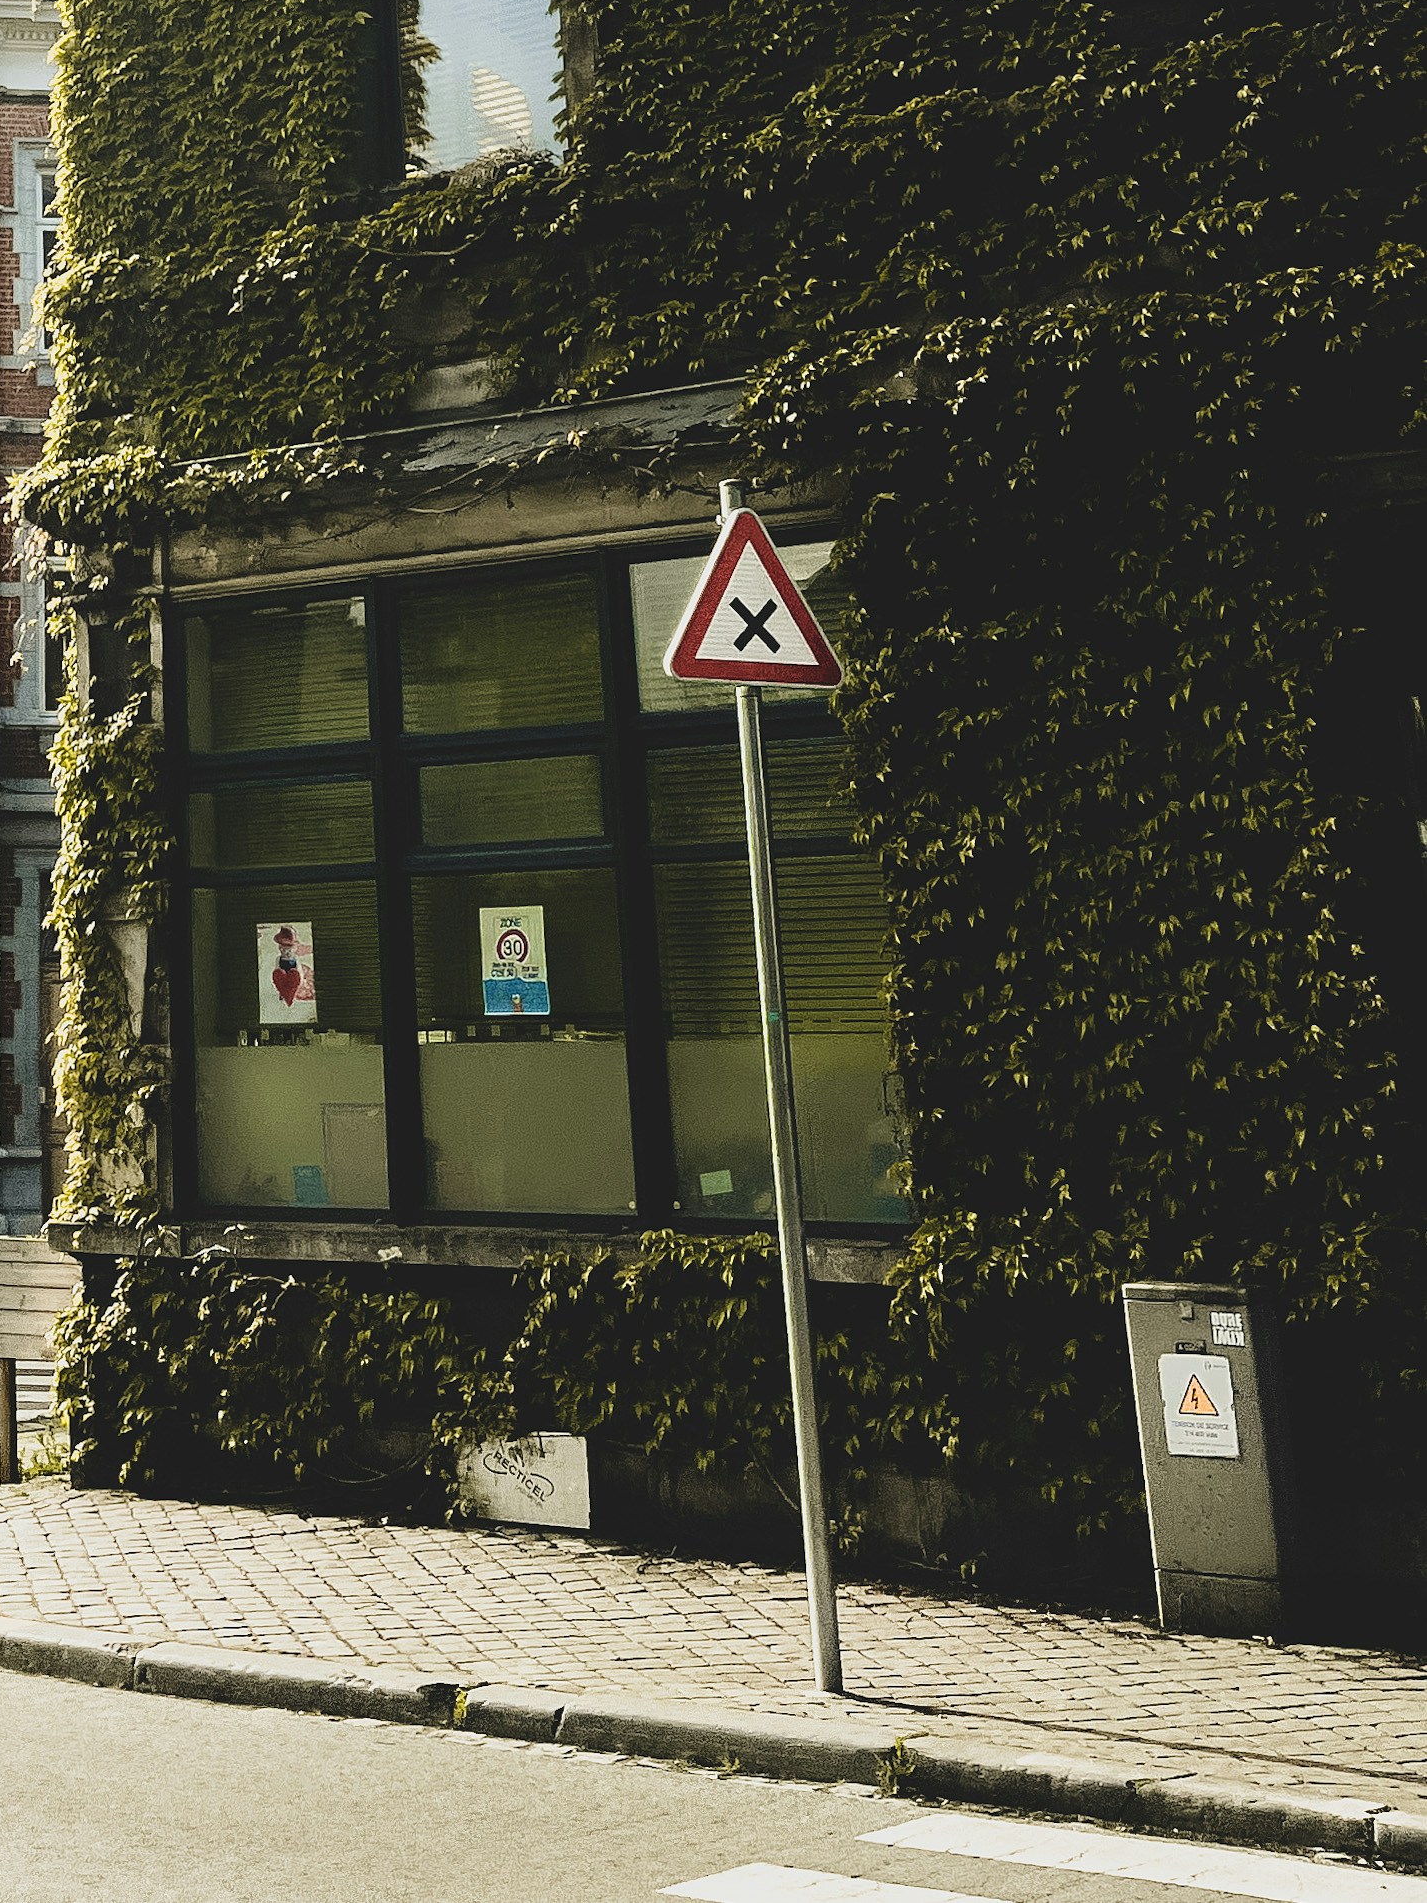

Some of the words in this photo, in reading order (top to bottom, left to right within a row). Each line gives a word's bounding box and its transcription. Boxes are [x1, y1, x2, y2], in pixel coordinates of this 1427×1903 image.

[499, 917, 522, 928] ZONE
[503, 940, 523, 956] 30
[493, 1451, 545, 1502] RECTICEL
